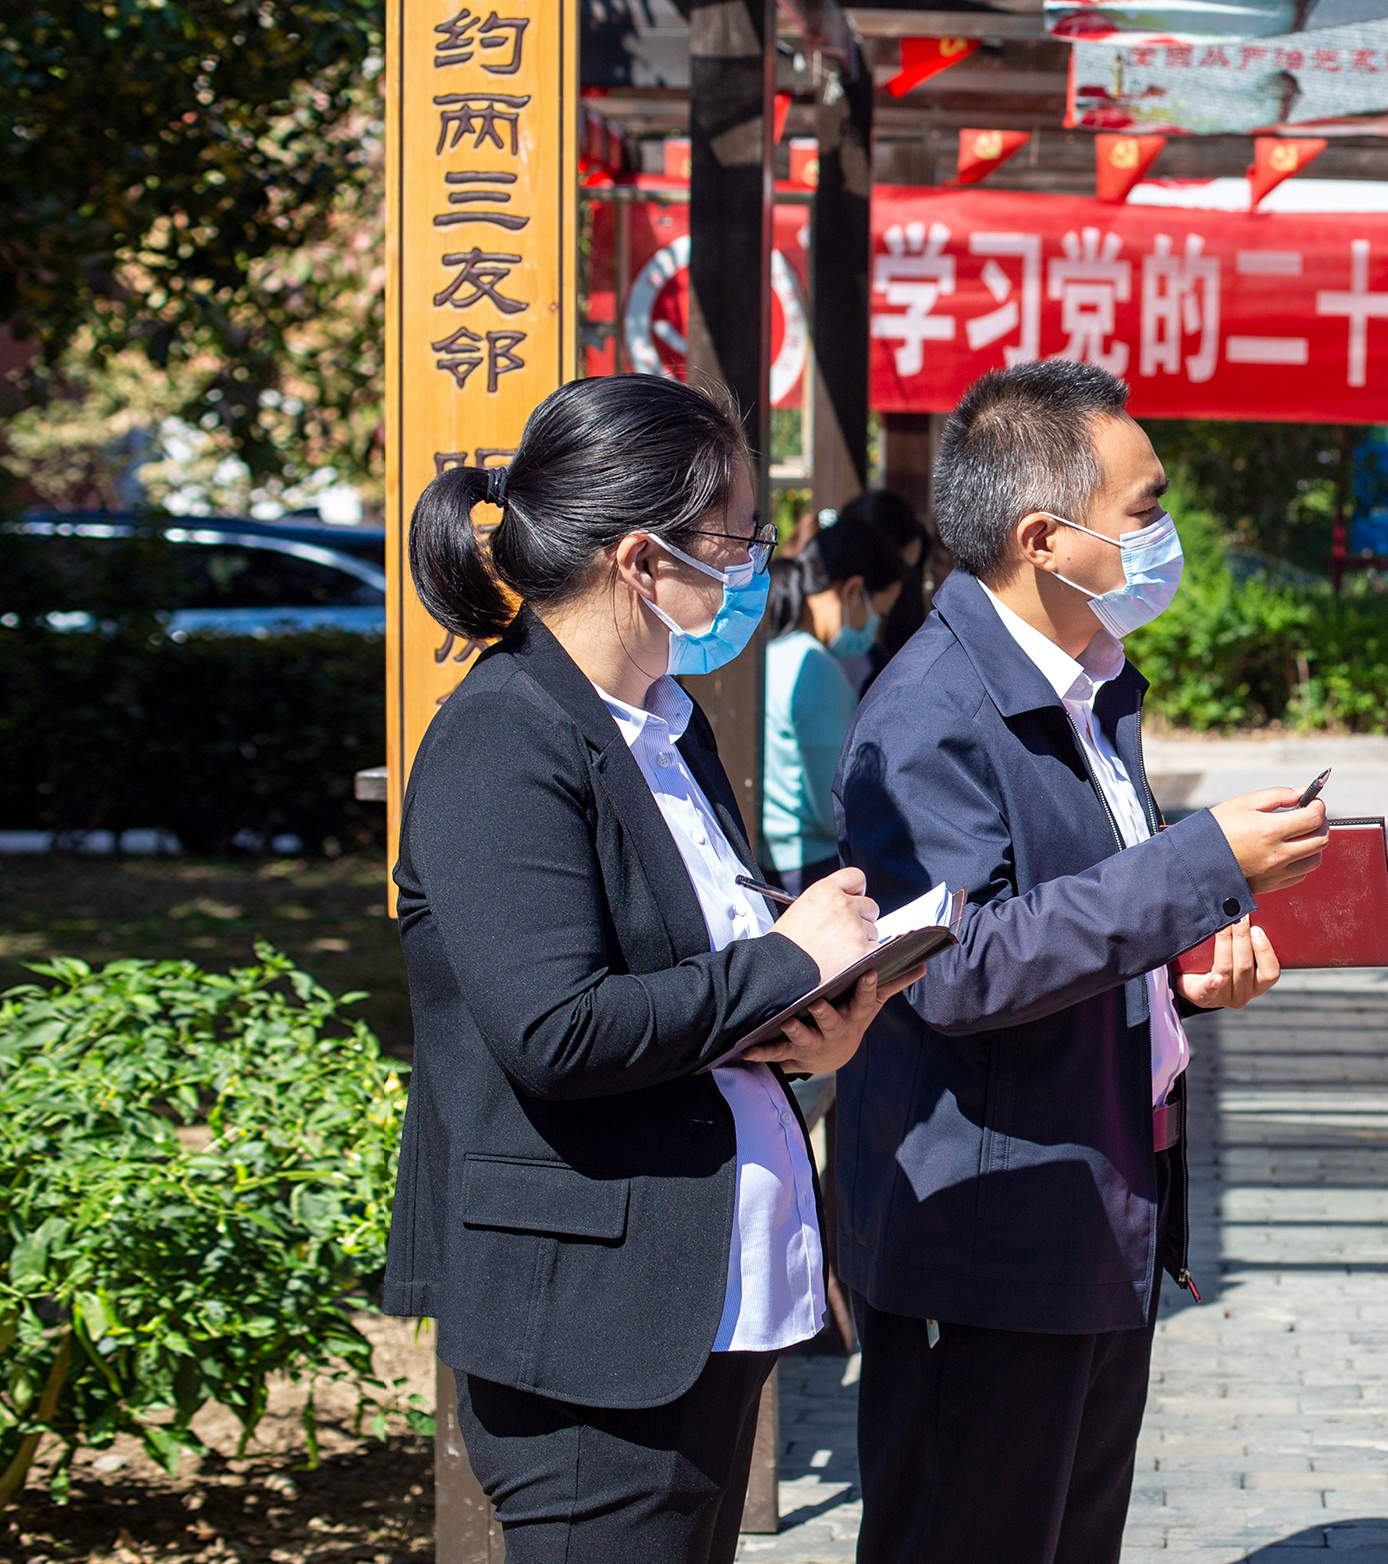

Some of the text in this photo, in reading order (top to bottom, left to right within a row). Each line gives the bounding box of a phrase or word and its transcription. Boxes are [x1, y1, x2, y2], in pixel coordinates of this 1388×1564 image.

[432, 8, 530, 393] 约两三友邻
